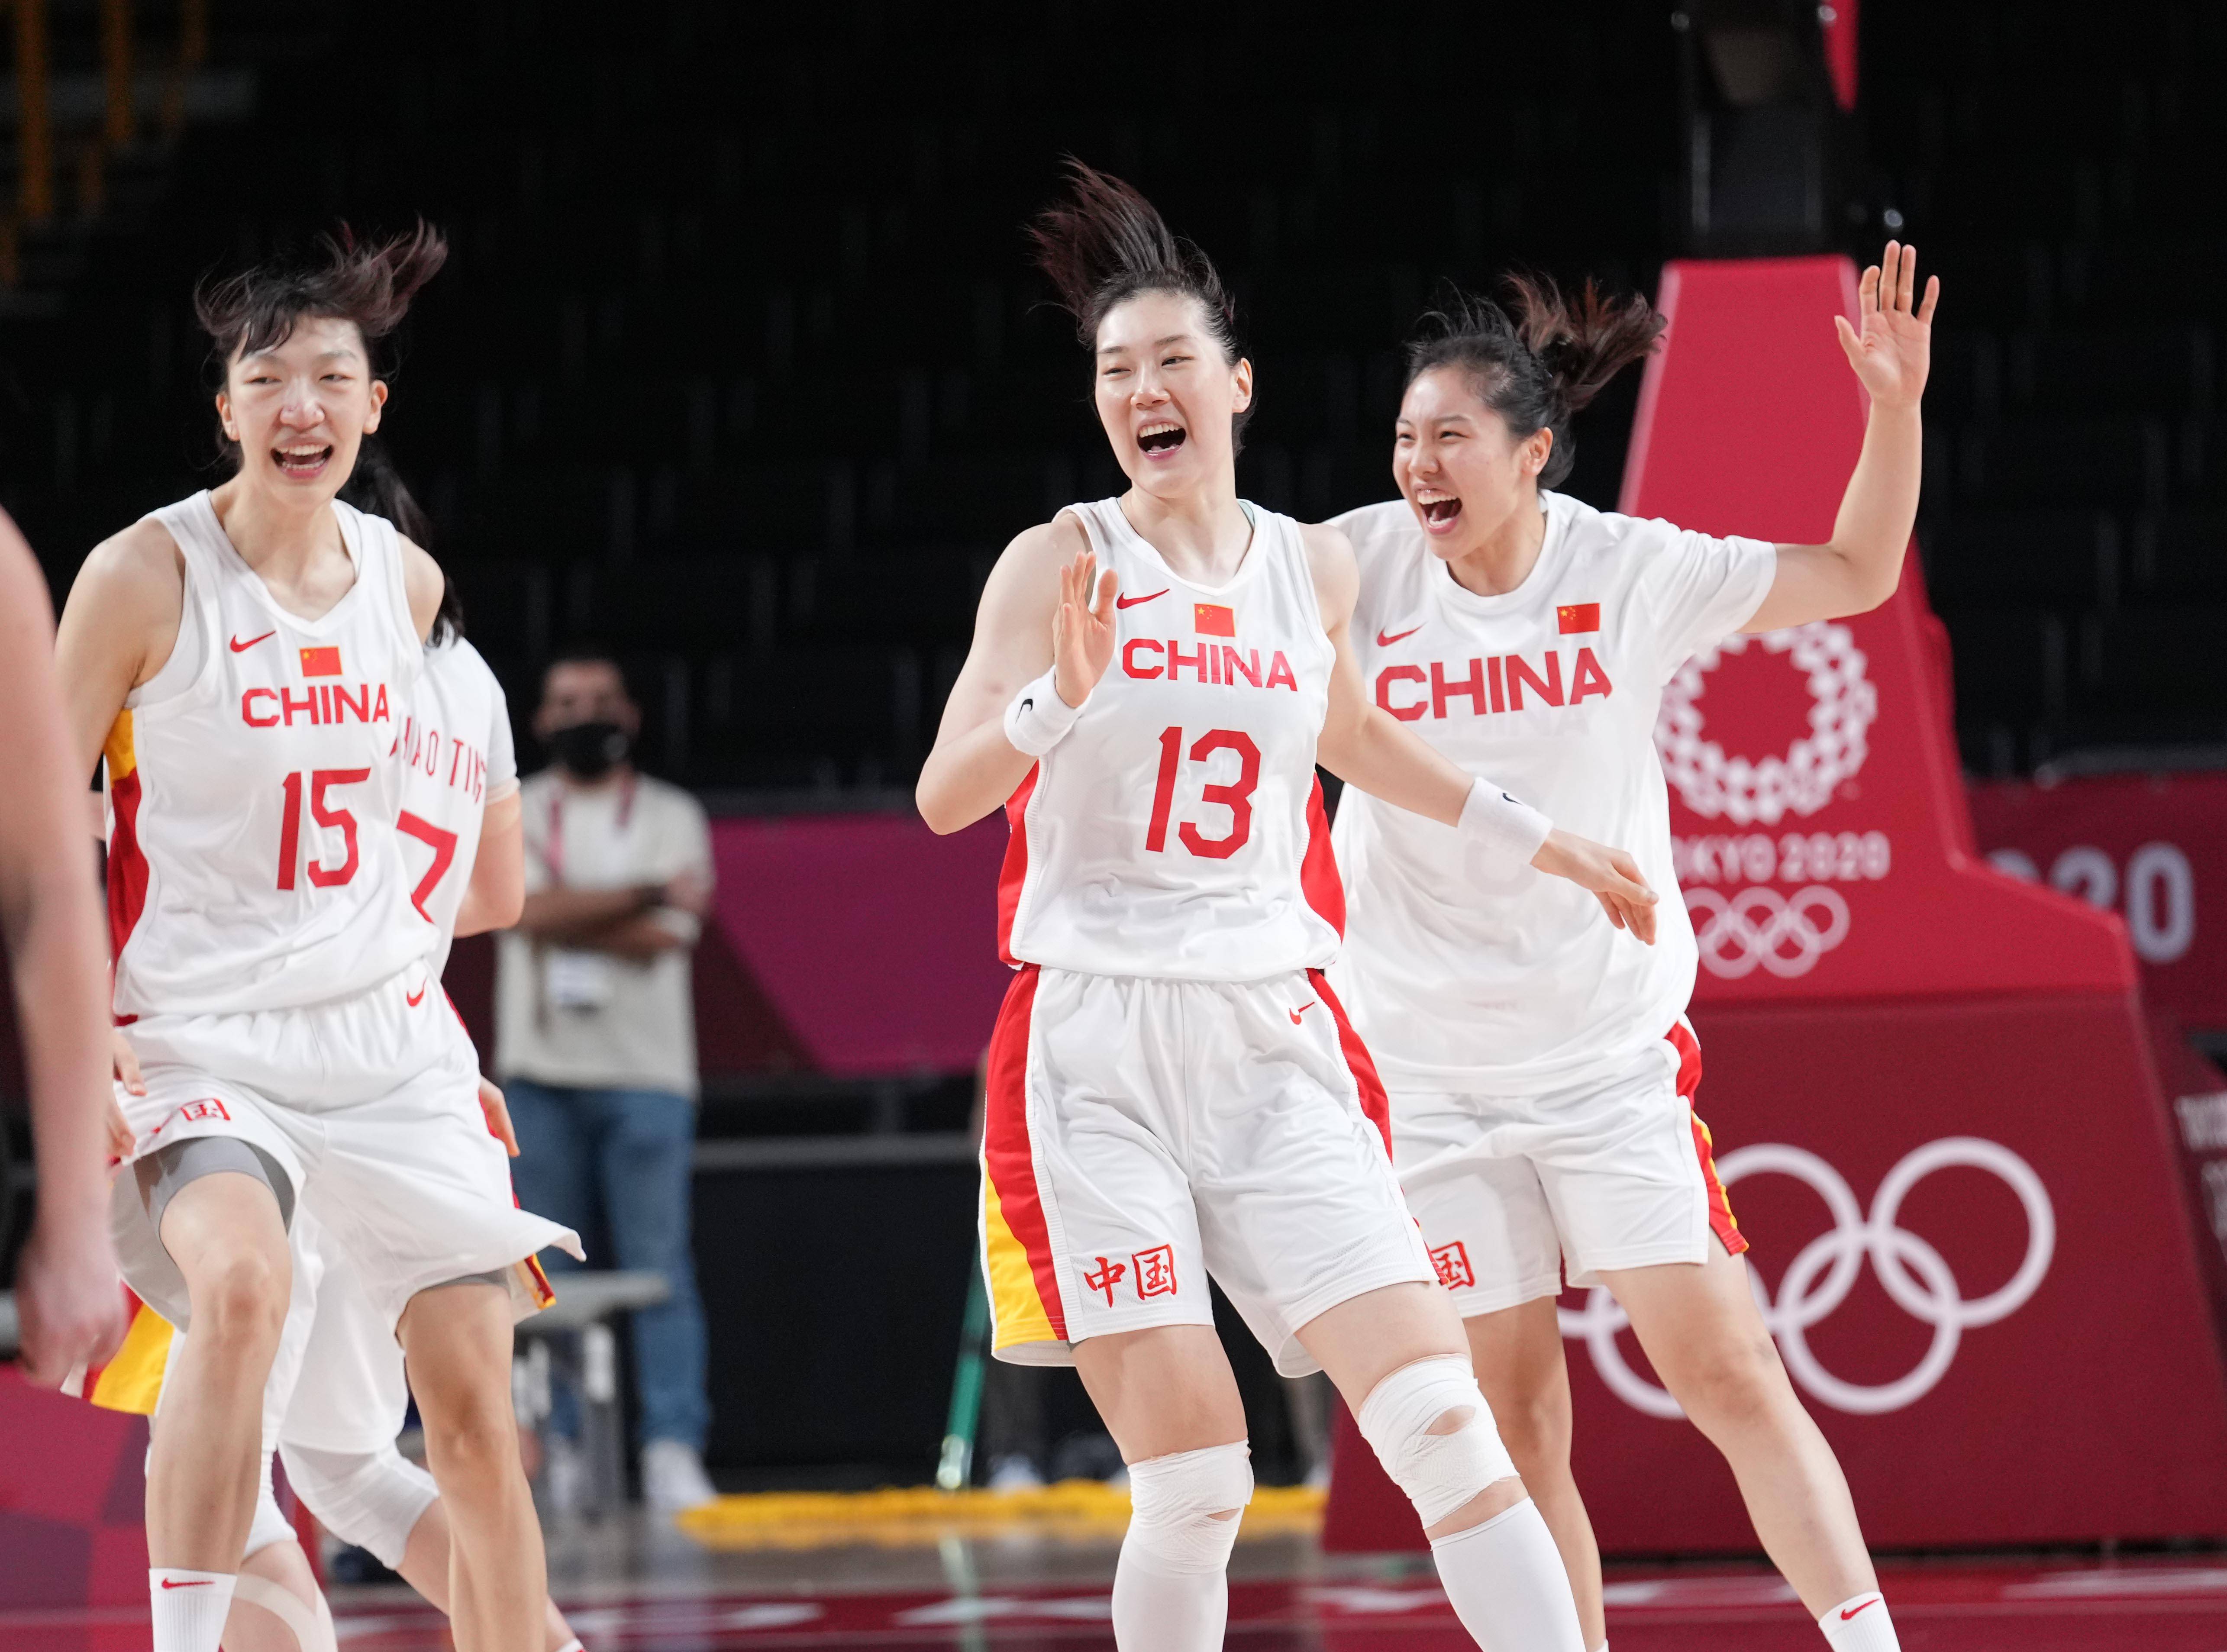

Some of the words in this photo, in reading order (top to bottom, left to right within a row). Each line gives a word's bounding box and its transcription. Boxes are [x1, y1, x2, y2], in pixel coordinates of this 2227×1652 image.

[1122, 638, 1298, 692] CHINA
[1376, 648, 1613, 721] CHINA
[242, 684, 390, 728] CHINA
[1146, 726, 1261, 859] 13
[277, 767, 371, 891] 15
[1778, 830, 1891, 883] 2020
[397, 810, 458, 923] 7
[1084, 1244, 1178, 1308] 中国
